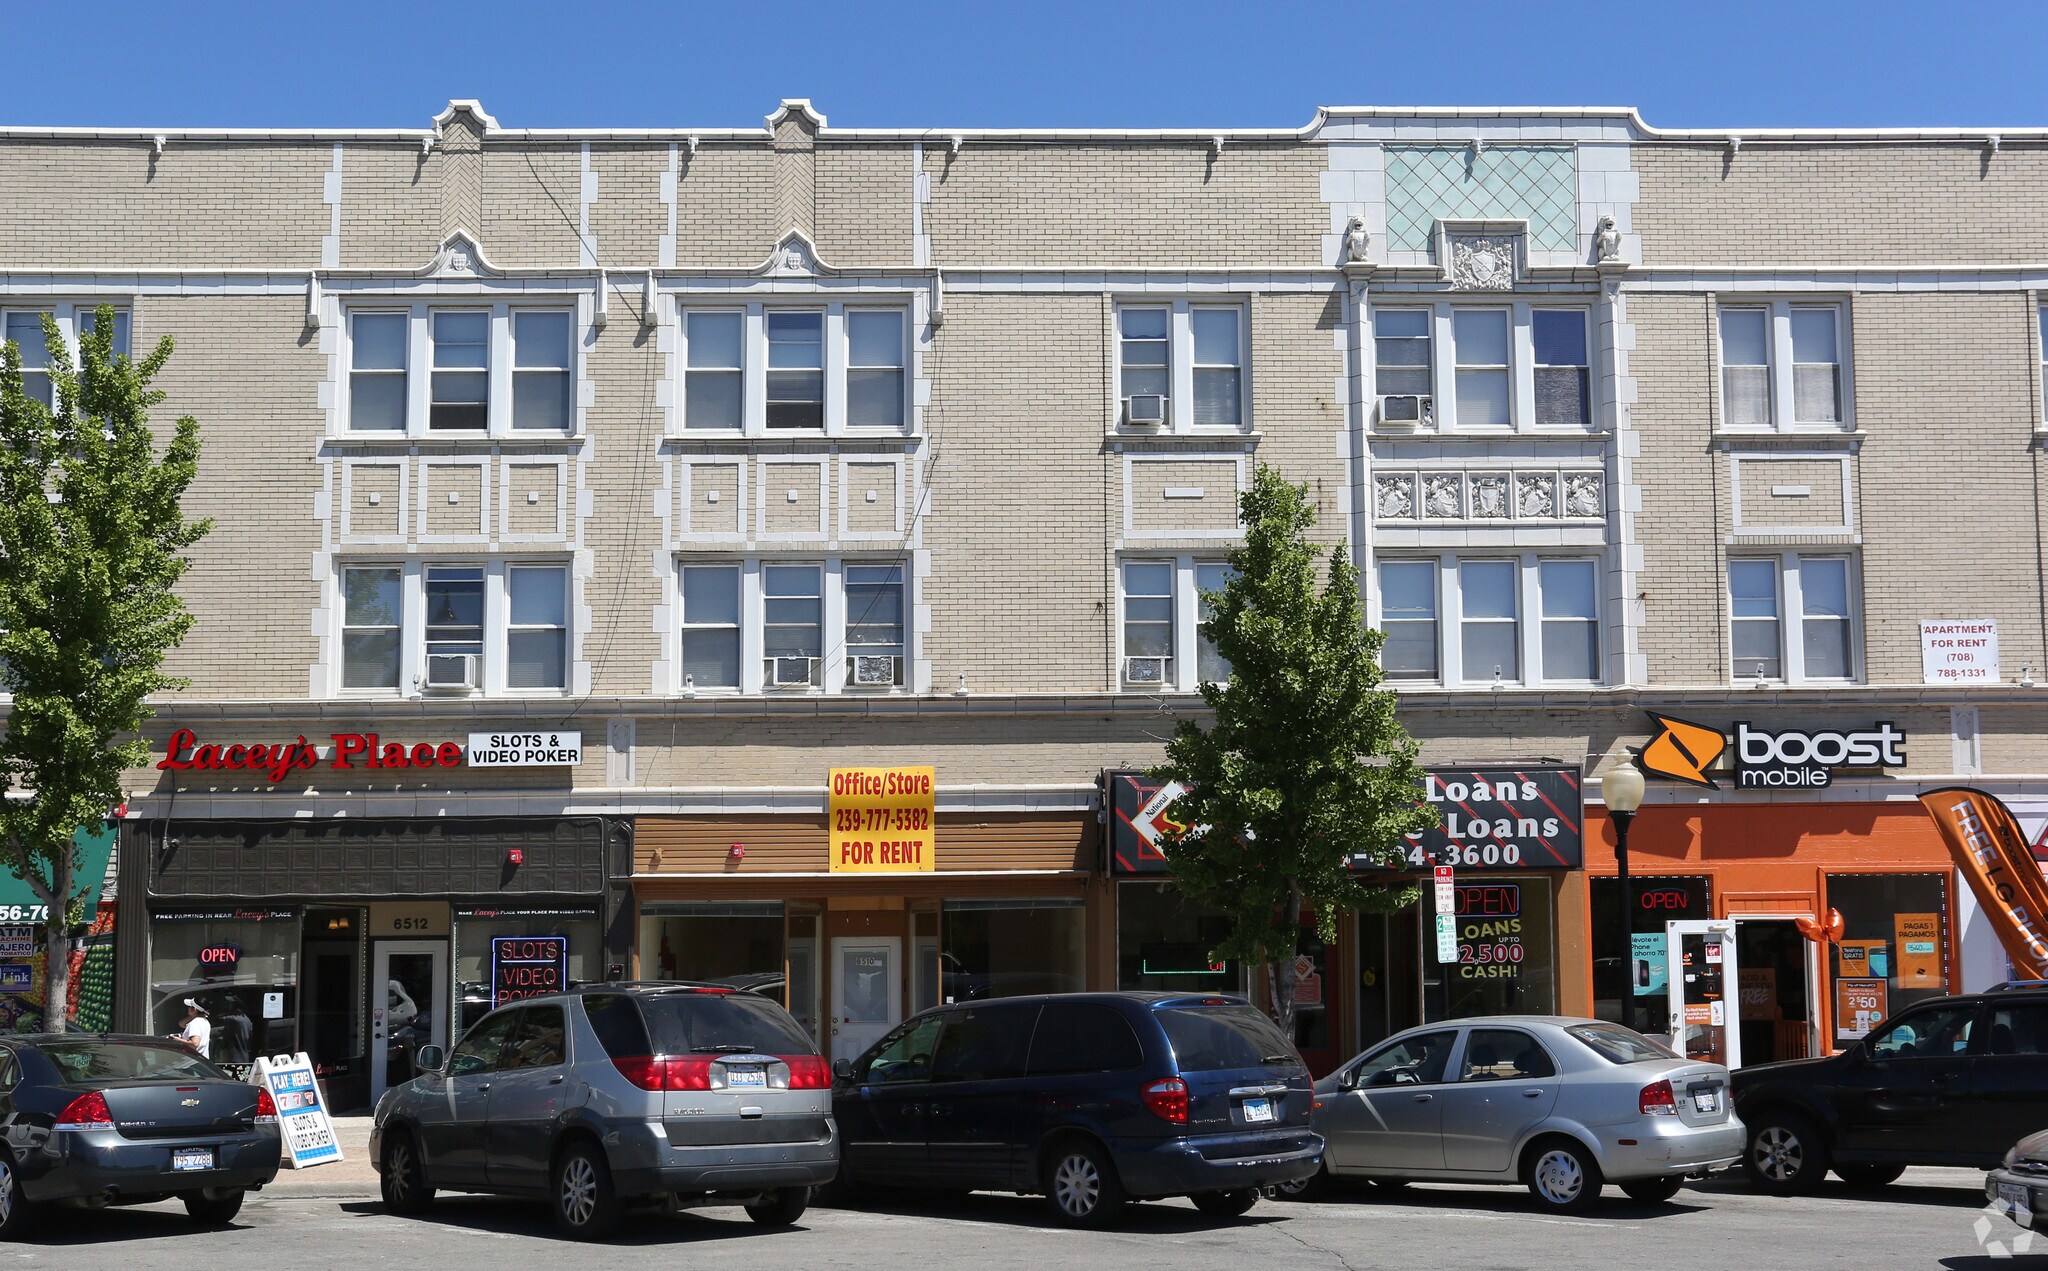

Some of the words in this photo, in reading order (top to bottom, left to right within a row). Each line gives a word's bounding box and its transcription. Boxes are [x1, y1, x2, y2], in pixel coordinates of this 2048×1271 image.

[1924, 625, 1993, 634] APARTMENT
[1931, 639, 1954, 648] FOR
[1957, 638, 1987, 647] RENT
[1946, 653, 1974, 663] (708)
[1937, 668, 1986, 677] 788-1331
[490, 734, 542, 748] SLOTS
[549, 734, 560, 747] &
[1739, 724, 1903, 764] boost
[156, 728, 317, 782] Lacey's
[330, 733, 461, 769] Place
[473, 750, 520, 763] VIDEO
[524, 749, 578, 762] POKER
[834, 772, 930, 798] Office/Store
[1425, 776, 1540, 802] Loans
[1145, 793, 1169, 818] National
[836, 808, 928, 831] 239-777-5382
[1447, 812, 1560, 839] Loans
[842, 841, 874, 864] FOR
[880, 841, 923, 864] RENT
[1950, 799, 1998, 867] FREE
[1985, 866, 2015, 904] LG
[1454, 888, 1517, 914] OPEN
[1641, 892, 1688, 909] OPEN
[233, 908, 269, 921] Lacey's
[394, 918, 428, 930] 6512
[1903, 922, 1929, 930] PAGAS
[1898, 930, 1936, 938] PAGAMOS
[201, 948, 236, 963] OPEN
[501, 942, 558, 960] SLOTS
[1456, 943, 1524, 965] 2,500
[503, 968, 557, 985] VIDEO
[1460, 965, 1518, 979] CASH!
[1848, 996, 1856, 1006] 2
[272, 1073, 289, 1089] PLAY
[291, 1071, 311, 1088] HERE!
